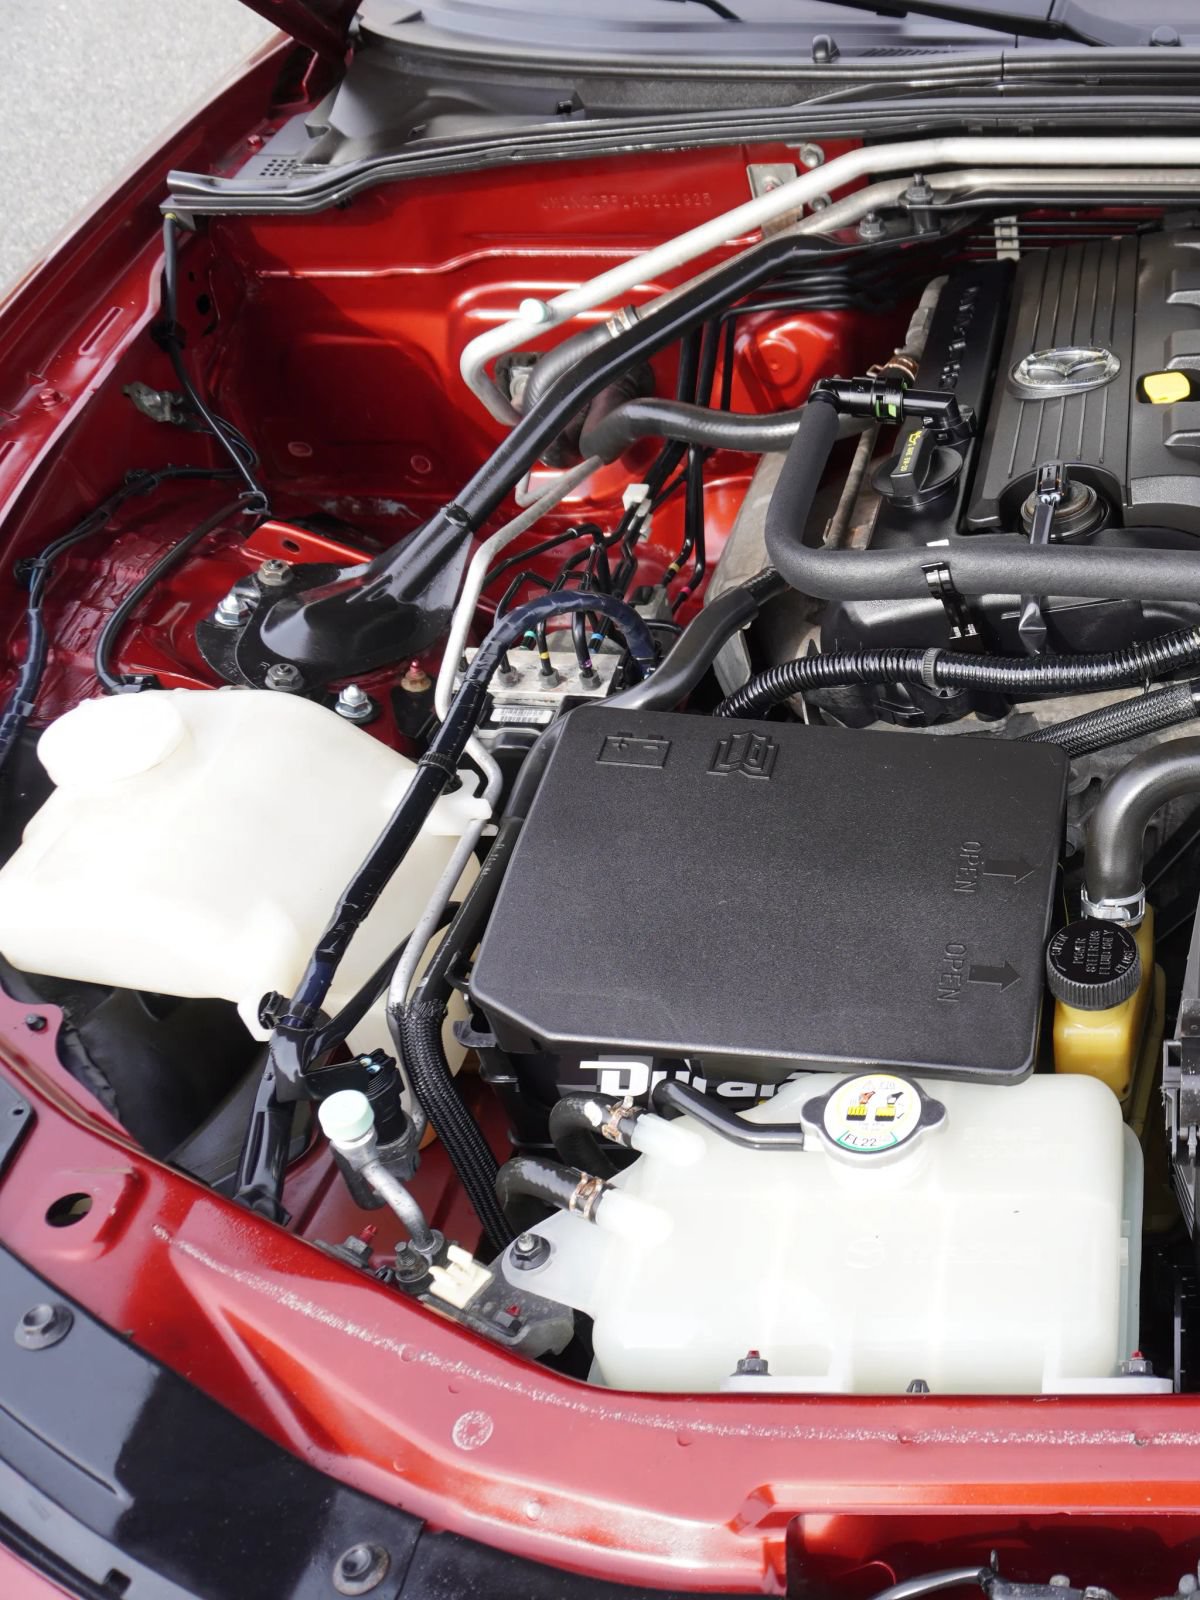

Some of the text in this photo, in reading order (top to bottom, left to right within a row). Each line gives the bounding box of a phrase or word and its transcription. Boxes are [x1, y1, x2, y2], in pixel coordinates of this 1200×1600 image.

[953, 841, 982, 893] OPEN
[936, 943, 967, 1002] OPEN
[1085, 930, 1101, 973] STEERING
